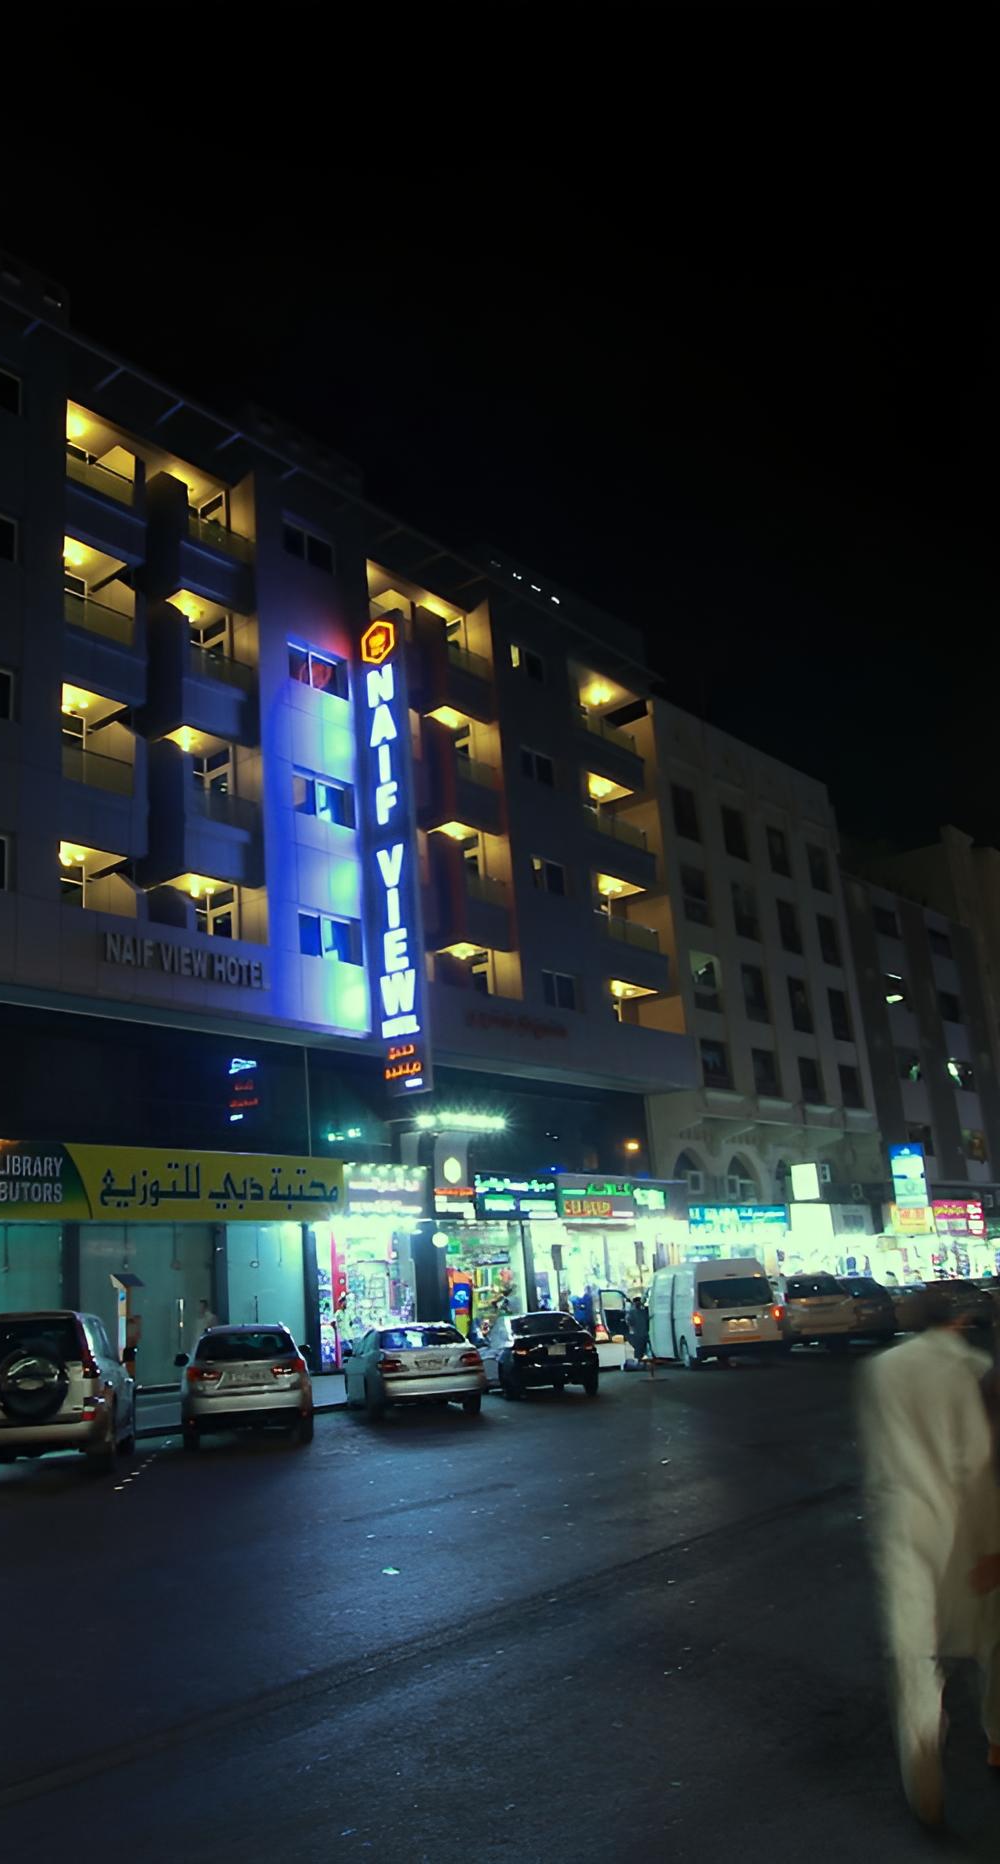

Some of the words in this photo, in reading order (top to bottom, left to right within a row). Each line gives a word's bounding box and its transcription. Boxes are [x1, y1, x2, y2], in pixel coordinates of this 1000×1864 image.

[366, 663, 398, 826] NAIF
[376, 843, 416, 1017] VIEW
[105, 932, 154, 968] NAIF
[160, 943, 209, 979] VIEW
[213, 953, 271, 990] HOTEL
[99, 1162, 201, 1208] للتوزيع
[207, 1171, 265, 1210] دبي
[268, 1167, 339, 1210] مكتبة
